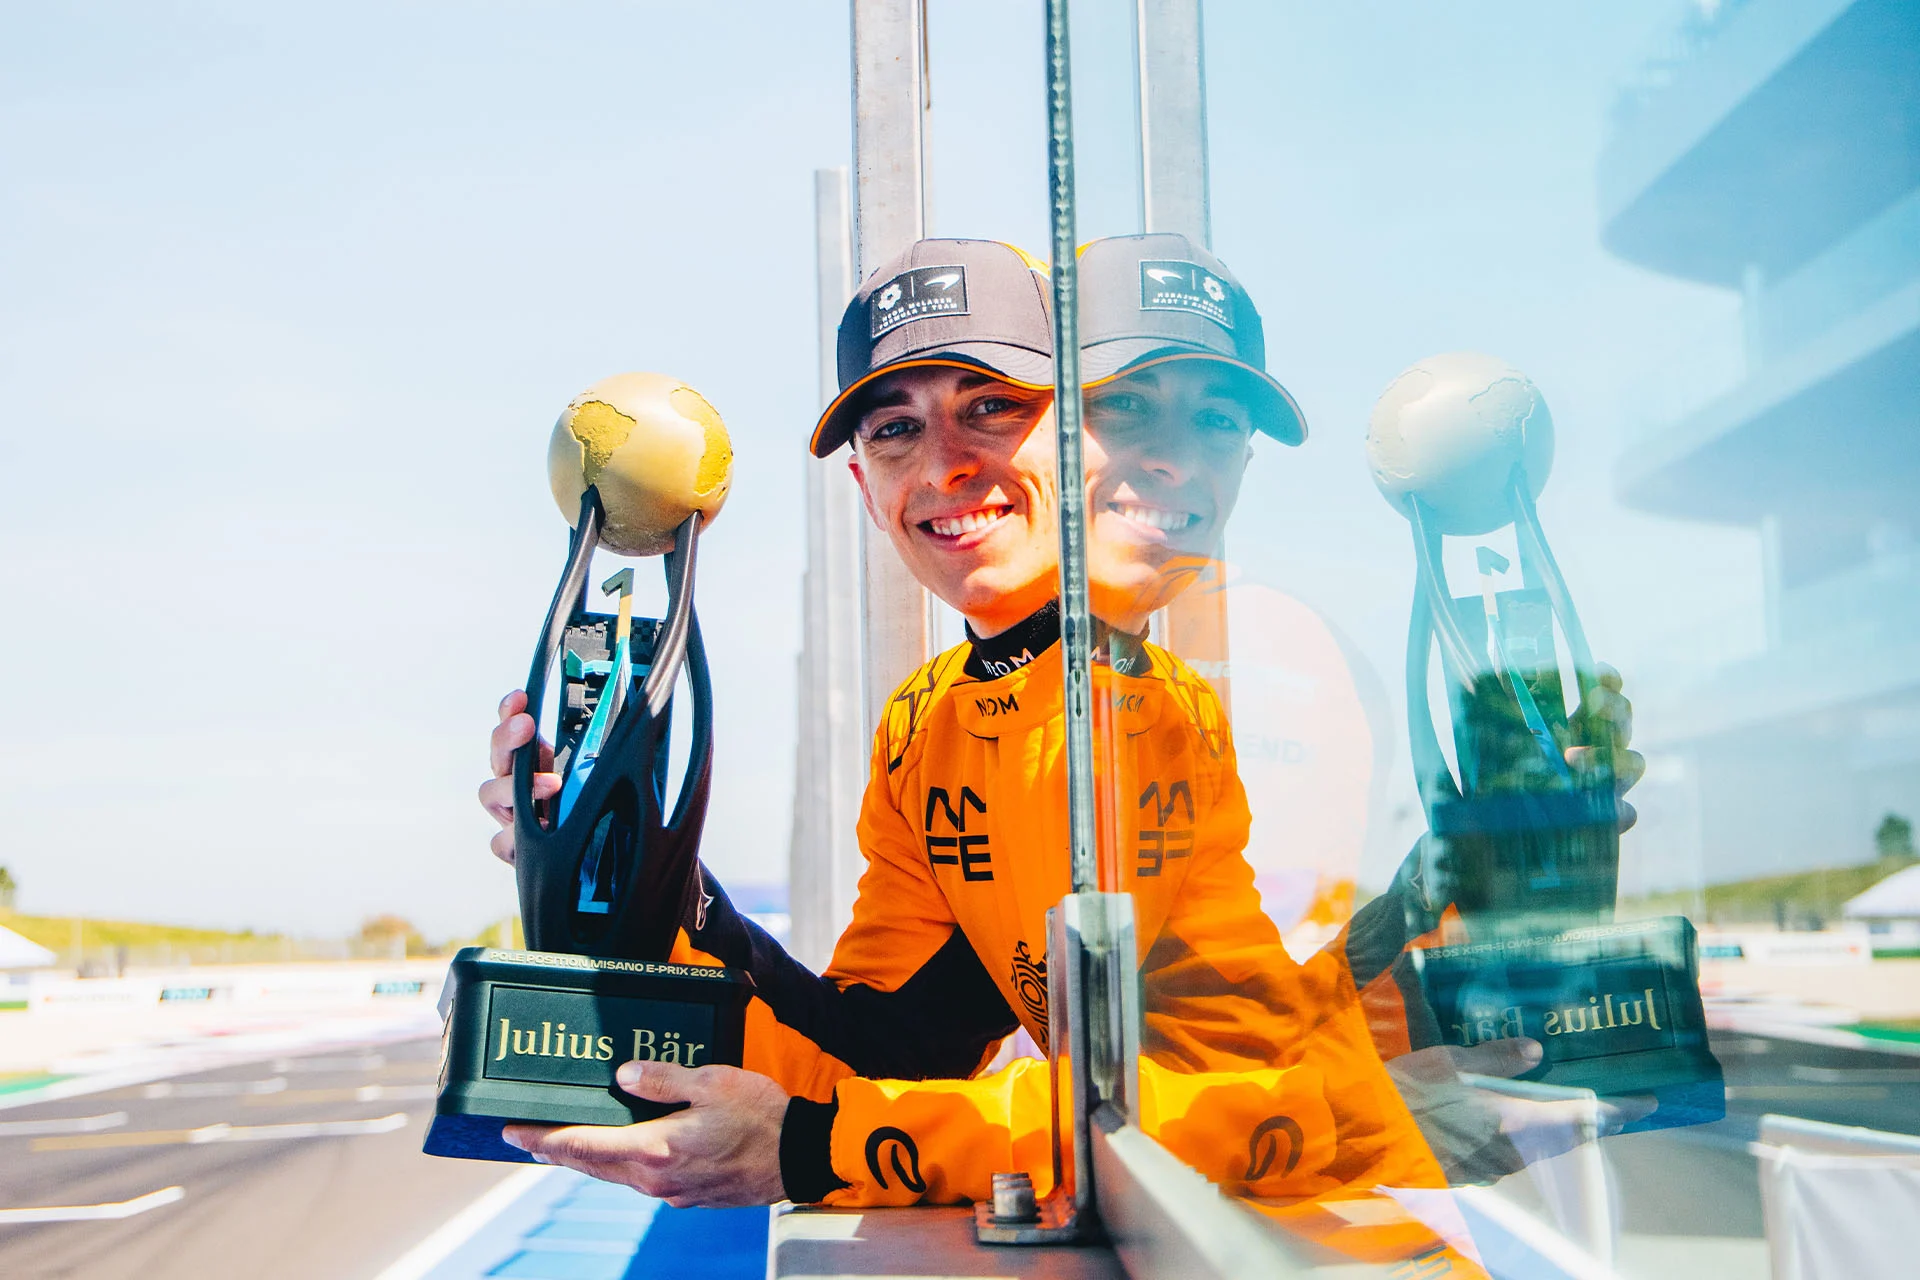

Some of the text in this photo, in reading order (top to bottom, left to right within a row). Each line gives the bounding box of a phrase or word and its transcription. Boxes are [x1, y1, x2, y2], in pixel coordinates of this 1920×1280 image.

[909, 297, 952, 309] McLAREN
[931, 303, 957, 311] TEAM
[490, 951, 726, 979] POLE POSITION MISANO E-PRIX 2024
[495, 1018, 705, 1067] Julius Bär
